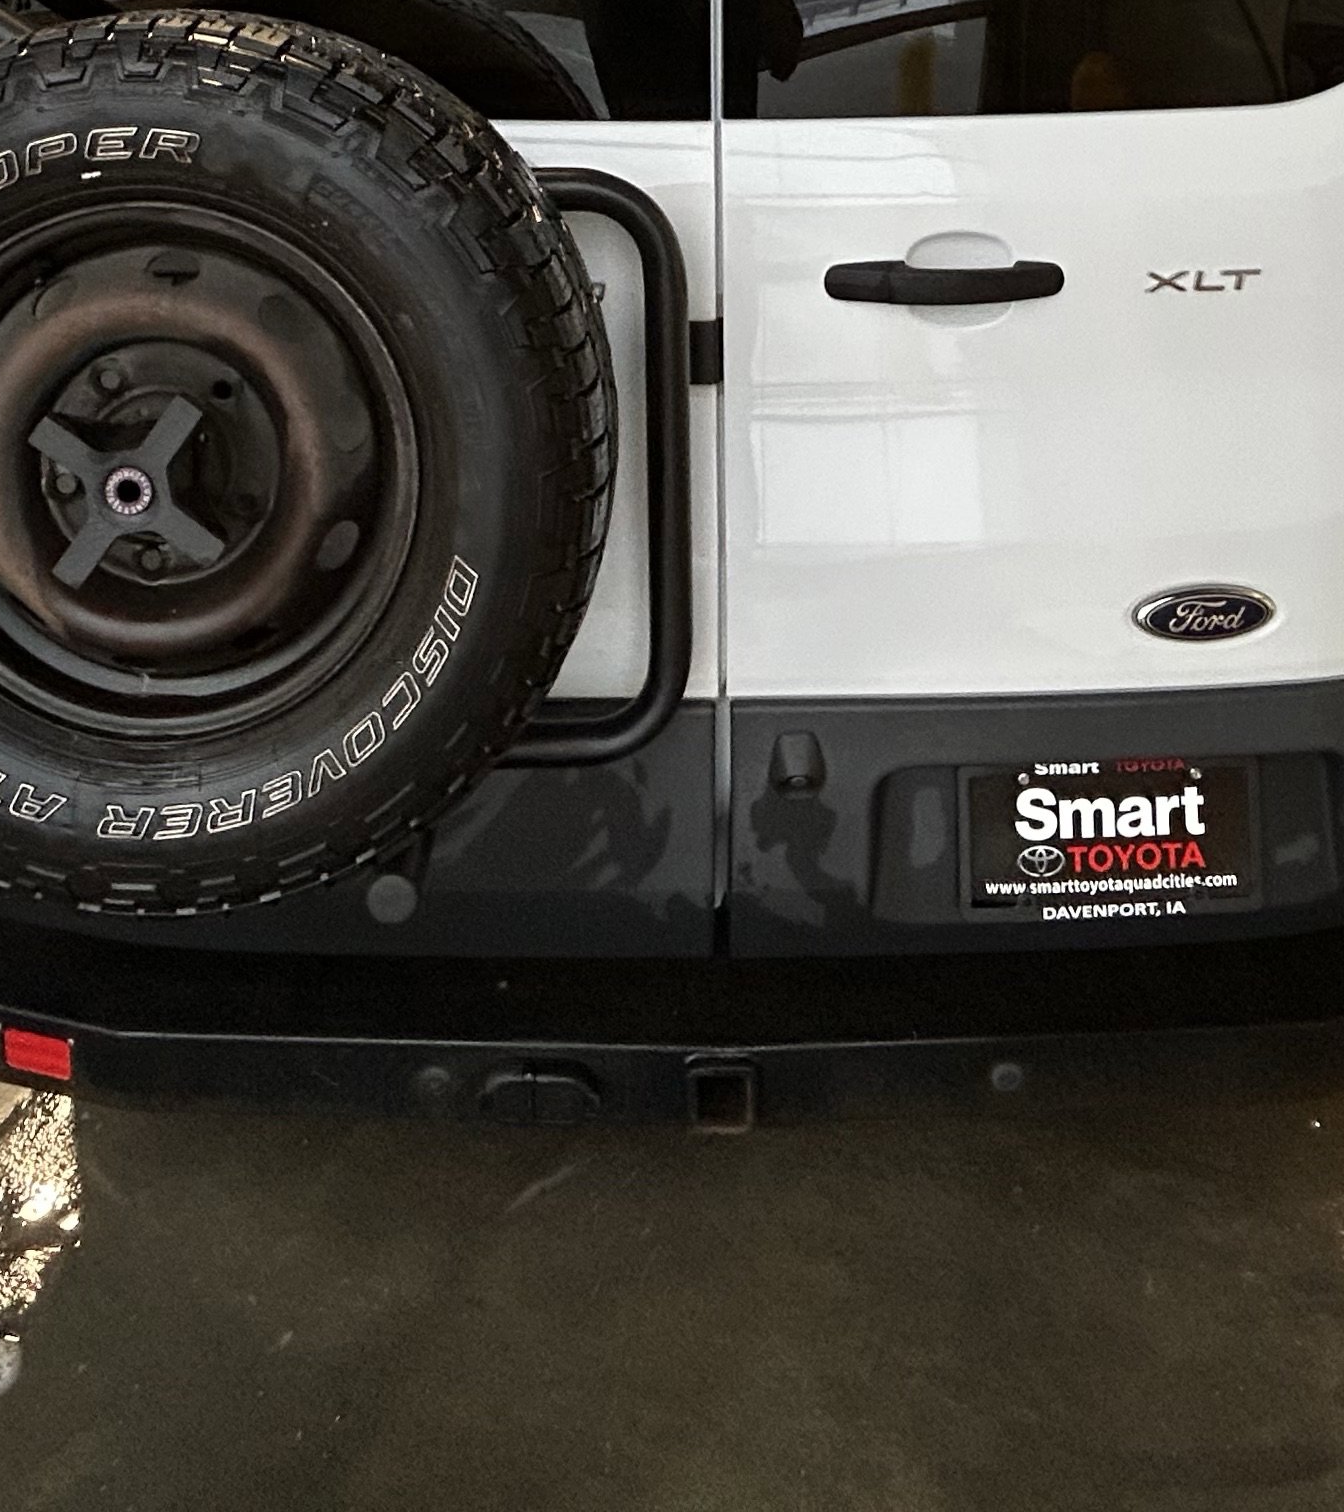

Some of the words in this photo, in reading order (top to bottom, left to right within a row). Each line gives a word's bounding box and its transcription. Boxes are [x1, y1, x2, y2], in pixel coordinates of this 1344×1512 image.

[1144, 268, 1262, 293] XLT
[1168, 600, 1246, 633] Ford
[97, 554, 479, 841] DISCOVERER
[1034, 761, 1100, 776] Smart
[1014, 786, 1206, 842] Smart
[1066, 840, 1206, 874] TOYOTA
[1042, 901, 1162, 920] DAVENPORT,
[1165, 900, 1187, 916] IA
